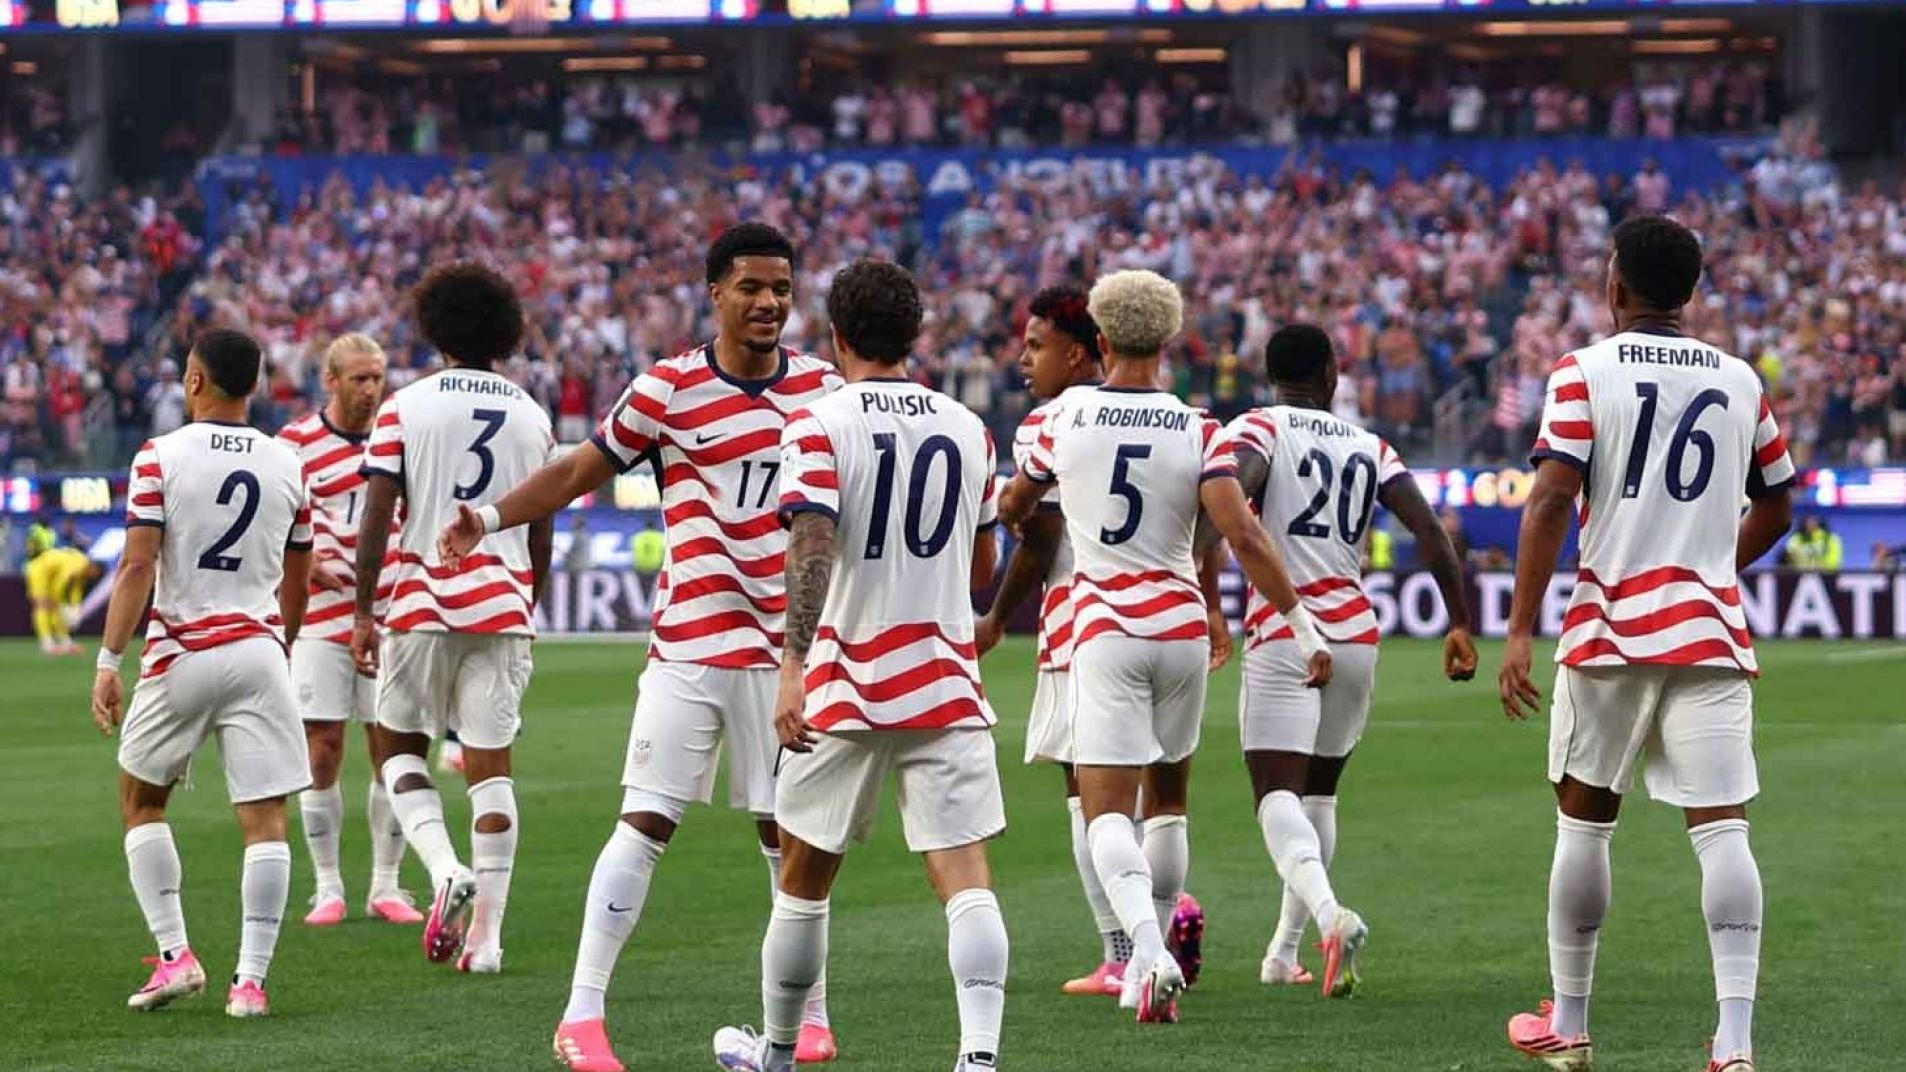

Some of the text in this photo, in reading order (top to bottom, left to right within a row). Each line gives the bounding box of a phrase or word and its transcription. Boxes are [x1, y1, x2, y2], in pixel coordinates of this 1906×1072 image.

[1618, 344, 1721, 370] FREEMAN
[211, 433, 254, 454] DEST
[453, 408, 507, 501] 3
[1095, 406, 1190, 431] ROBINSON
[1621, 381, 1730, 503] 16
[198, 469, 261, 573] 2
[736, 460, 781, 509] 17
[863, 432, 963, 561] 10
[1100, 443, 1153, 546] 5
[1287, 446, 1377, 546] 20
